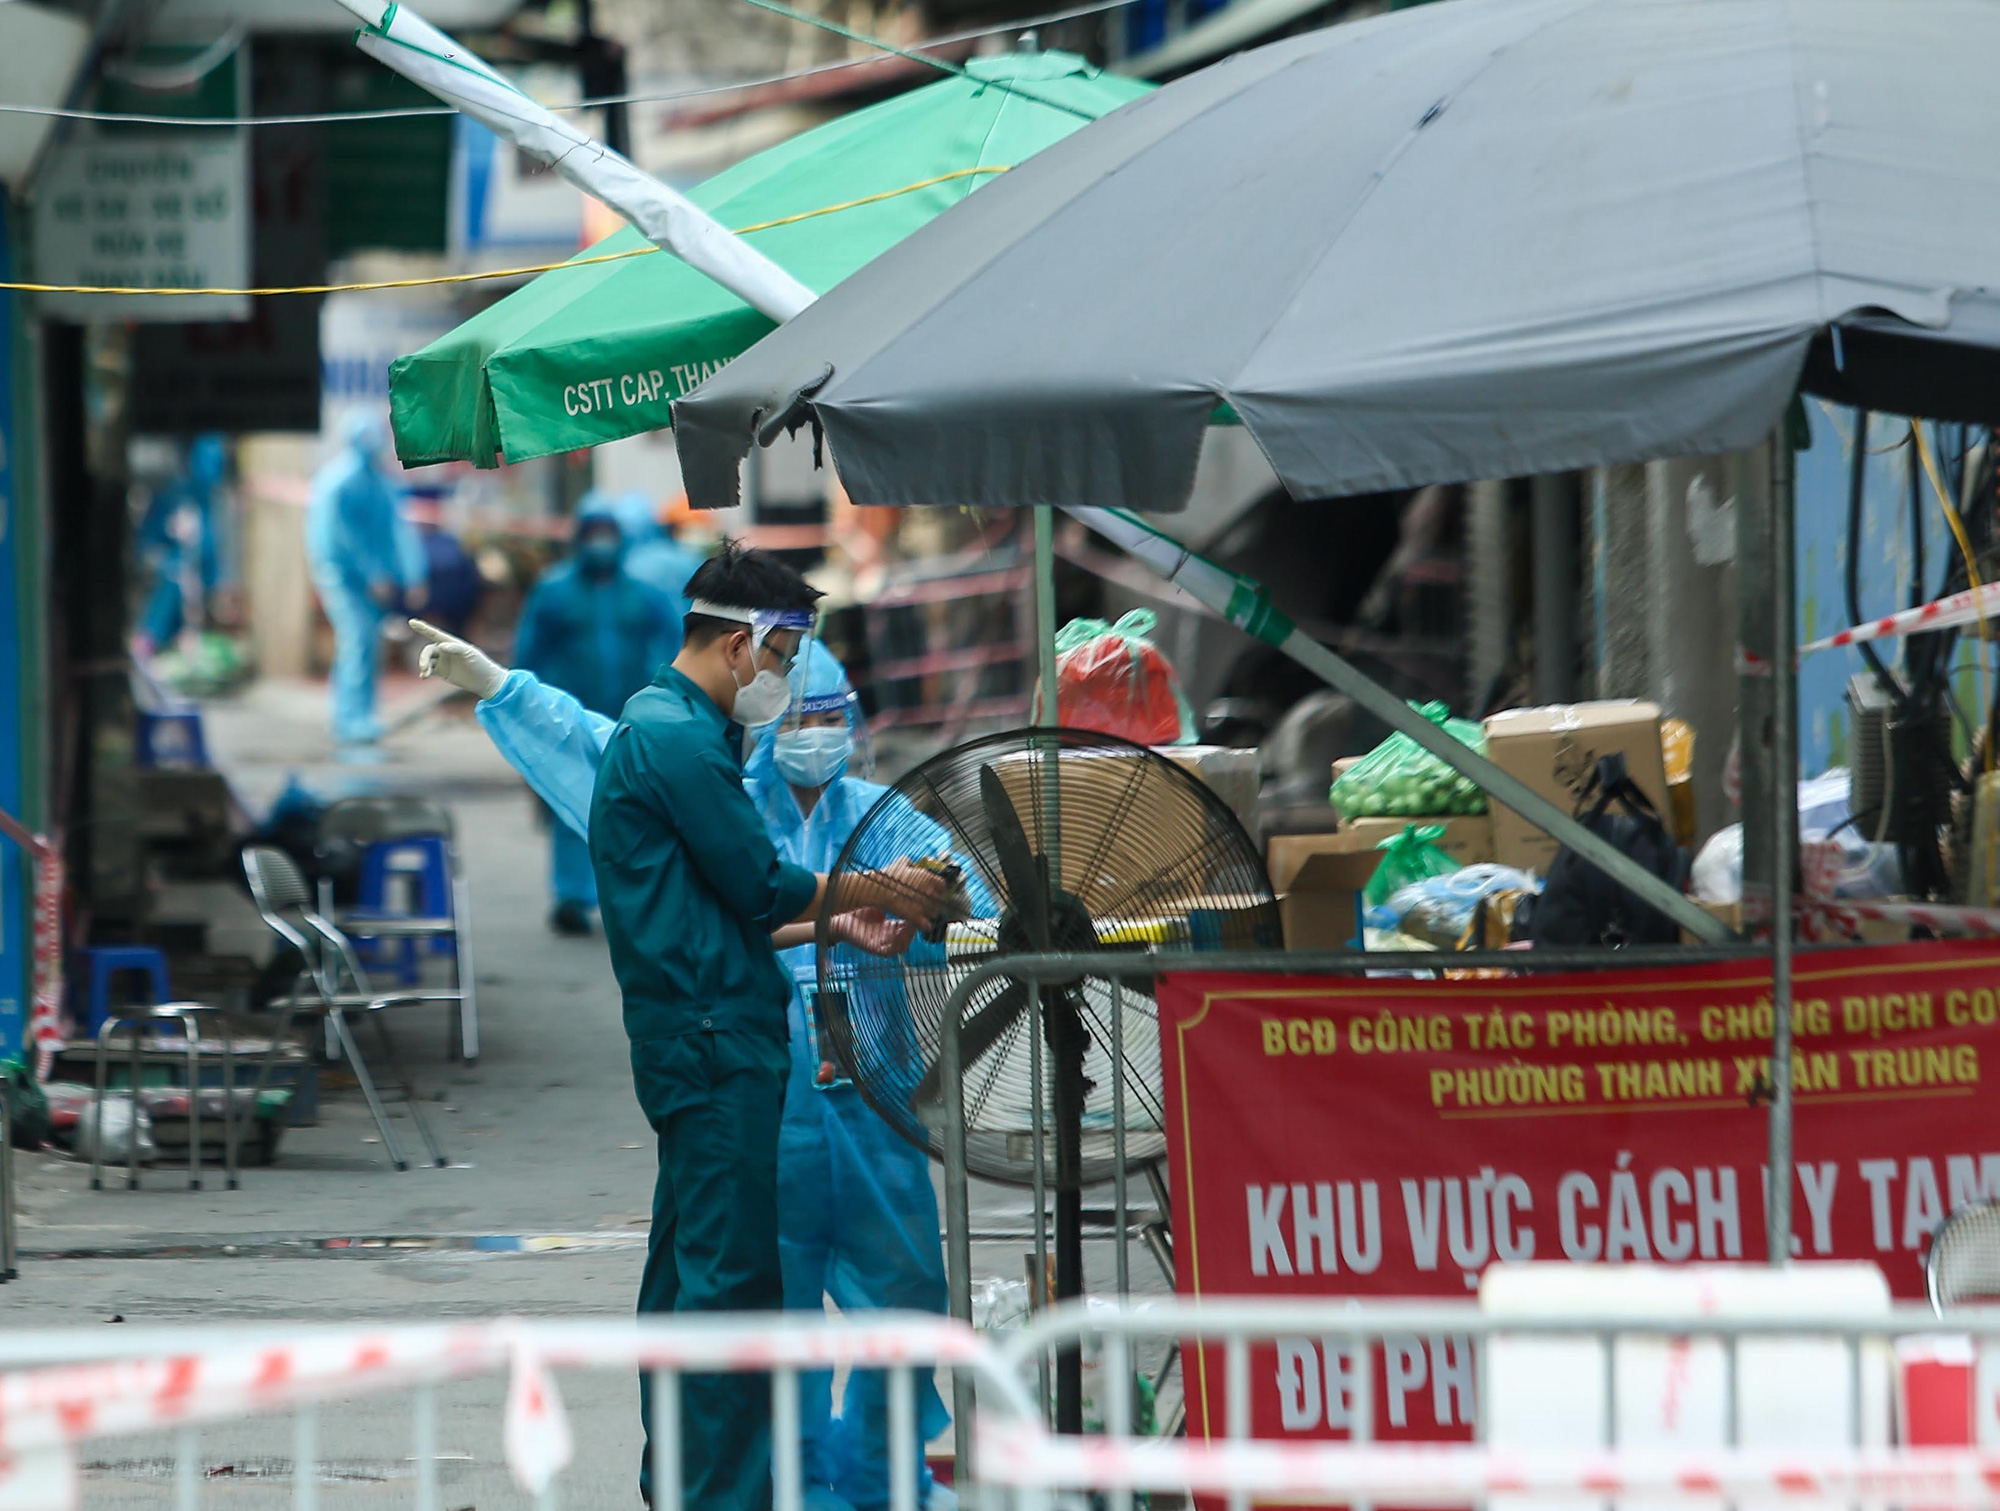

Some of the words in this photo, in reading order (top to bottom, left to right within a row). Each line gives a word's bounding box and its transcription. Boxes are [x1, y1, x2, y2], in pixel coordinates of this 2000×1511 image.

[563, 378, 614, 417] CSTT
[620, 369, 671, 406] CAP.
[1261, 1017, 1337, 1055] BCĐ
[1349, 1007, 1452, 1056] CÔNG
[1462, 1003, 1536, 1049] TÁC
[1842, 991, 1934, 1039] DỊCH
[1946, 985, 2000, 1027] CO
[1430, 1055, 1586, 1107] PHƯỜNG
[1594, 1057, 1723, 1100] THANH
[1847, 1043, 1980, 1088] TRUNG
[1245, 1176, 1384, 1277] KHU
[1400, 1164, 1536, 1290] VỰC
[1556, 1150, 1744, 1263] CÁCH
